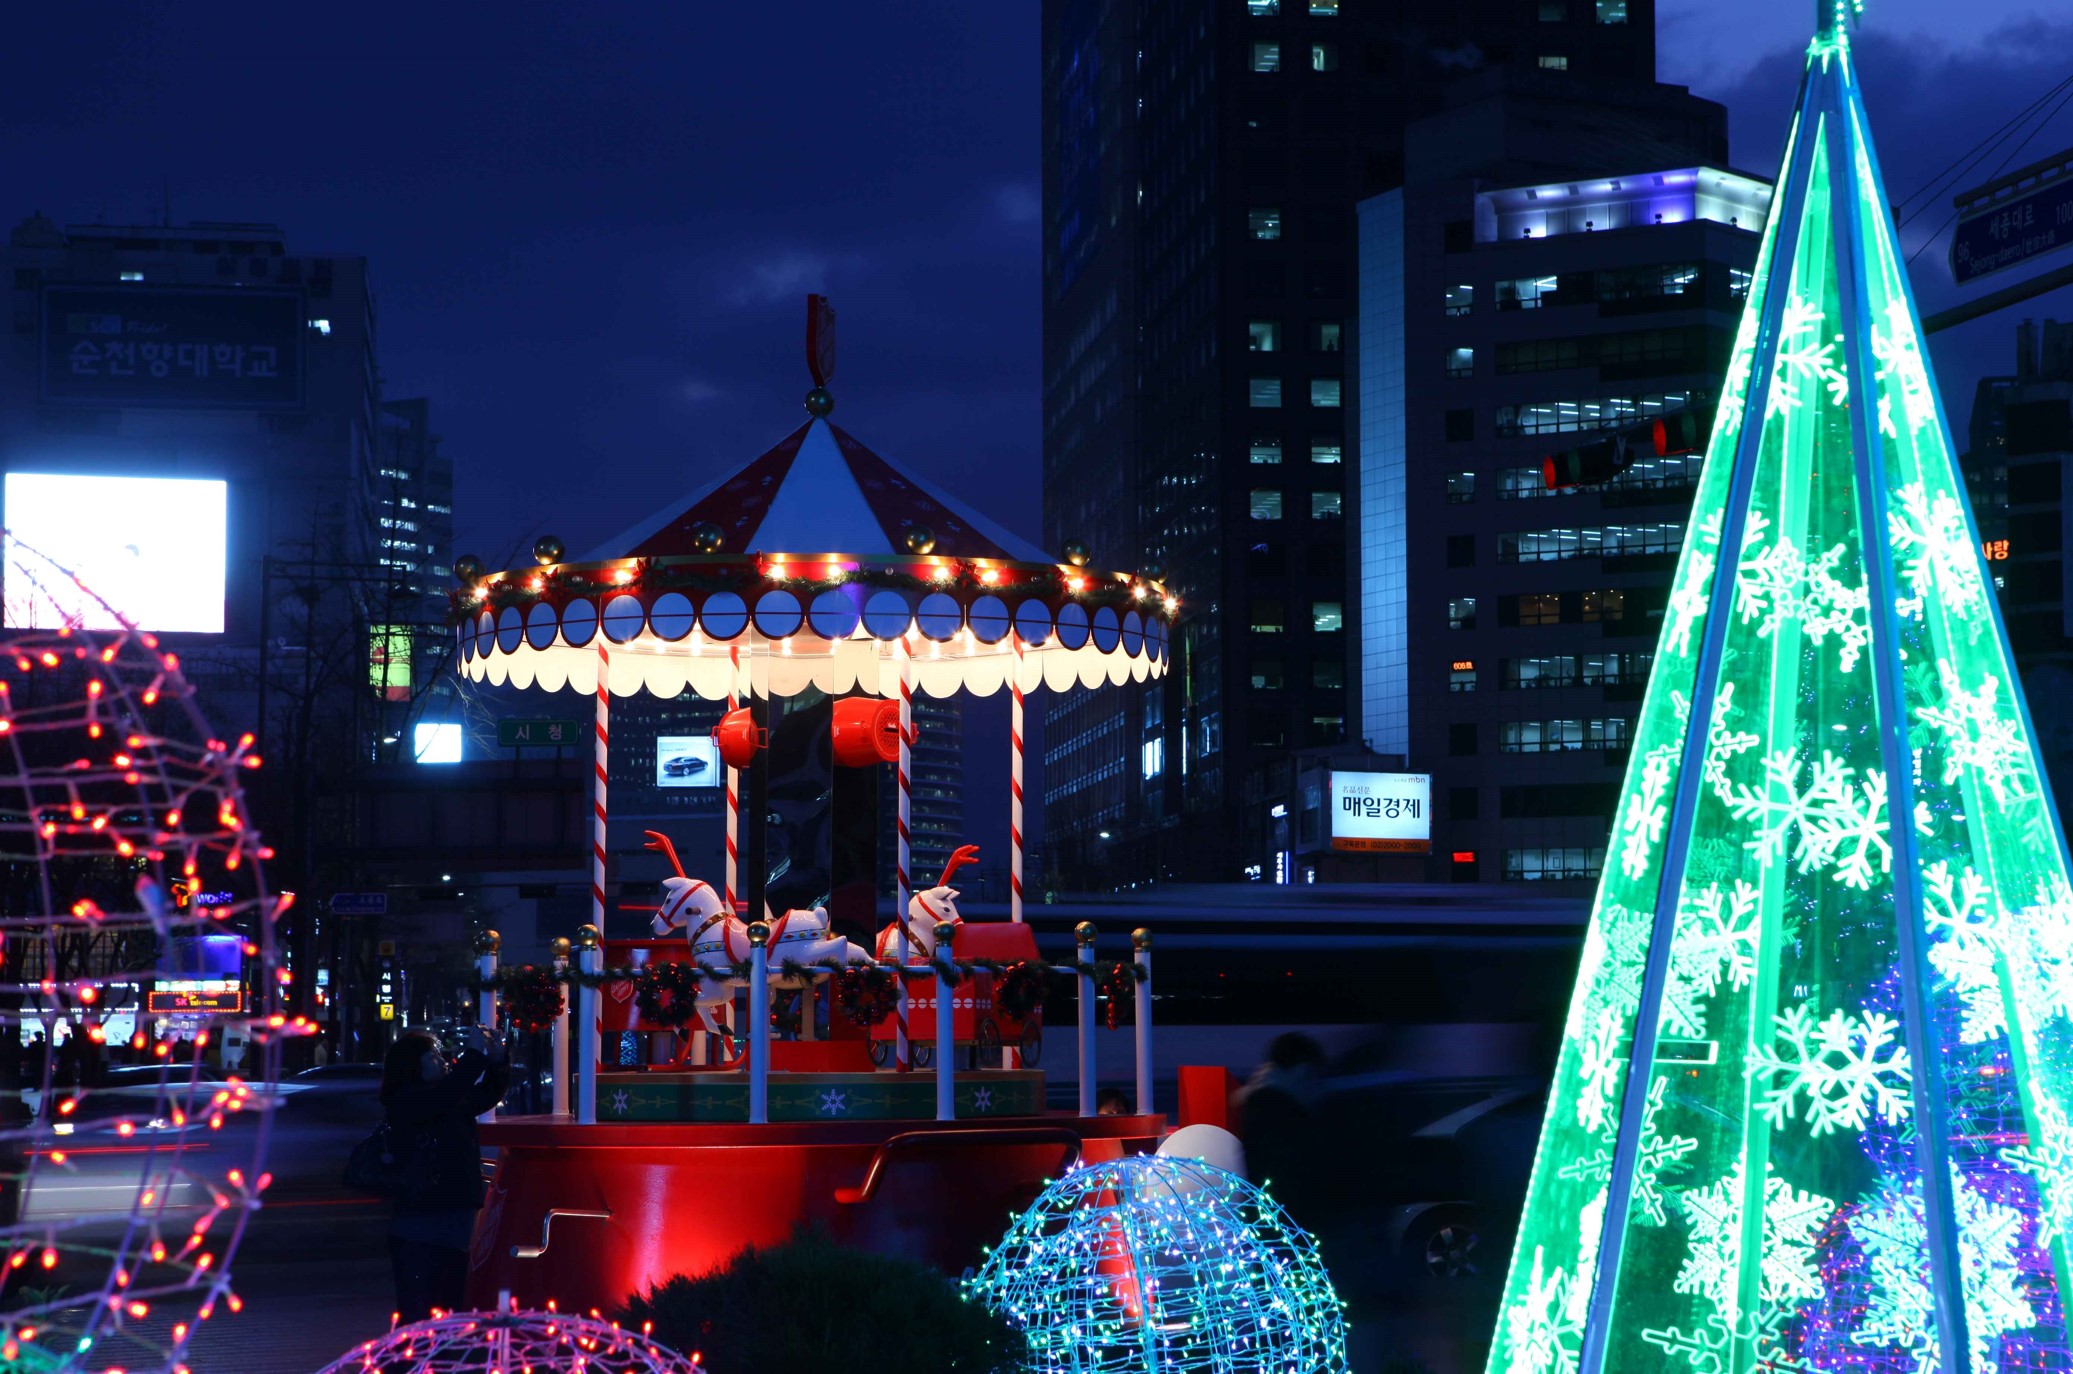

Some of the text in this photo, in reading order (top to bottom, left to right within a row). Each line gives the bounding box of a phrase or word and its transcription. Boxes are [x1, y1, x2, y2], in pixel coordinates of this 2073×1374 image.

[1988, 204, 2034, 240] 세종대로
[1957, 241, 1970, 263] 96
[68, 338, 279, 378] 순천향대학교
[1408, 776, 1426, 784] mbn
[1342, 796, 1421, 819] 매일경제
[174, 997, 188, 1006] SK
